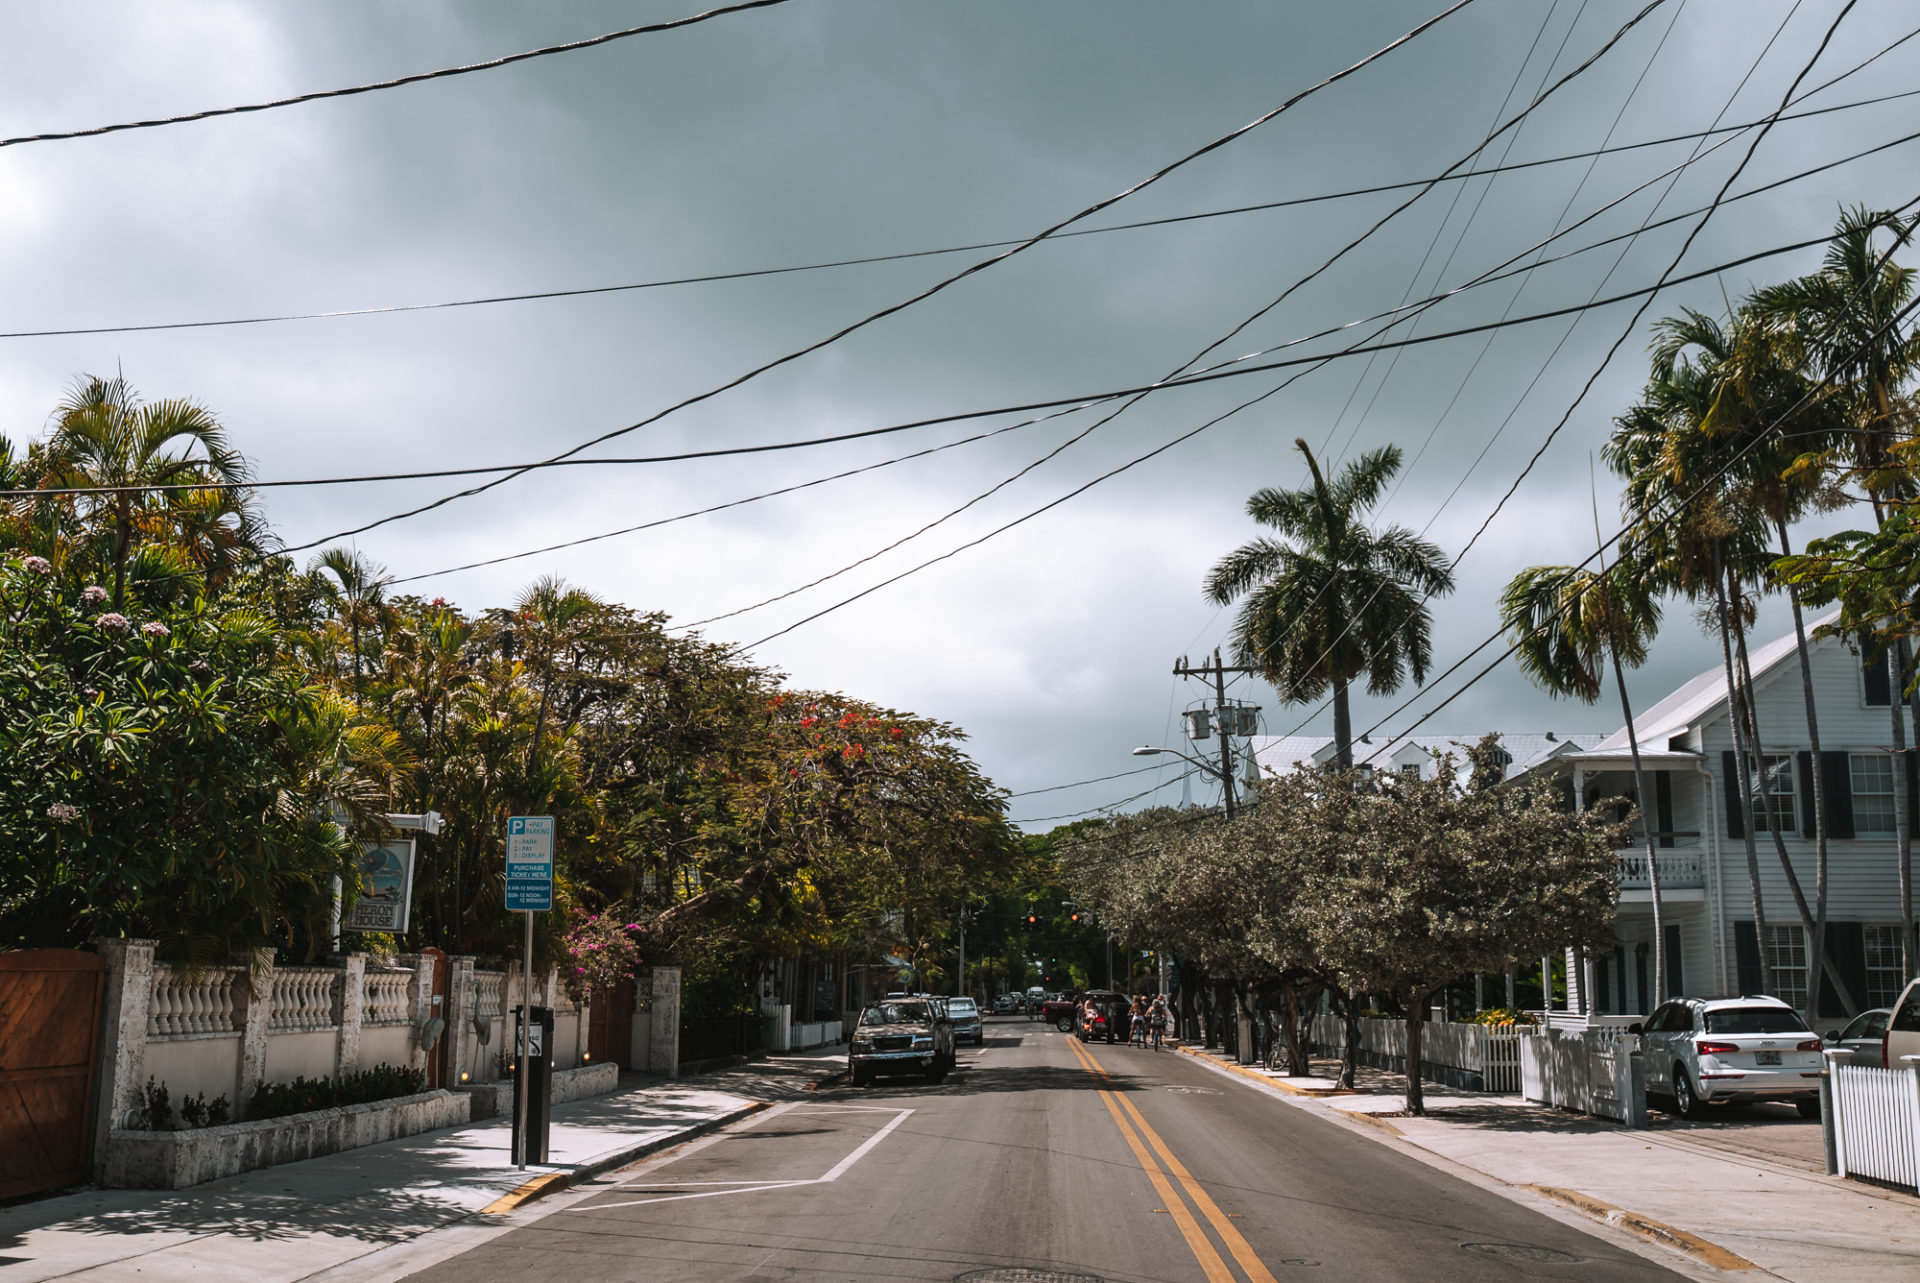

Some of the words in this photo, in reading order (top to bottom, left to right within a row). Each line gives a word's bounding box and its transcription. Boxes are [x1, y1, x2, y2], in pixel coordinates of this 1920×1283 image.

[512, 820, 523, 834] P
[356, 904, 394, 916] HERON
[354, 915, 392, 926] HOUSE
